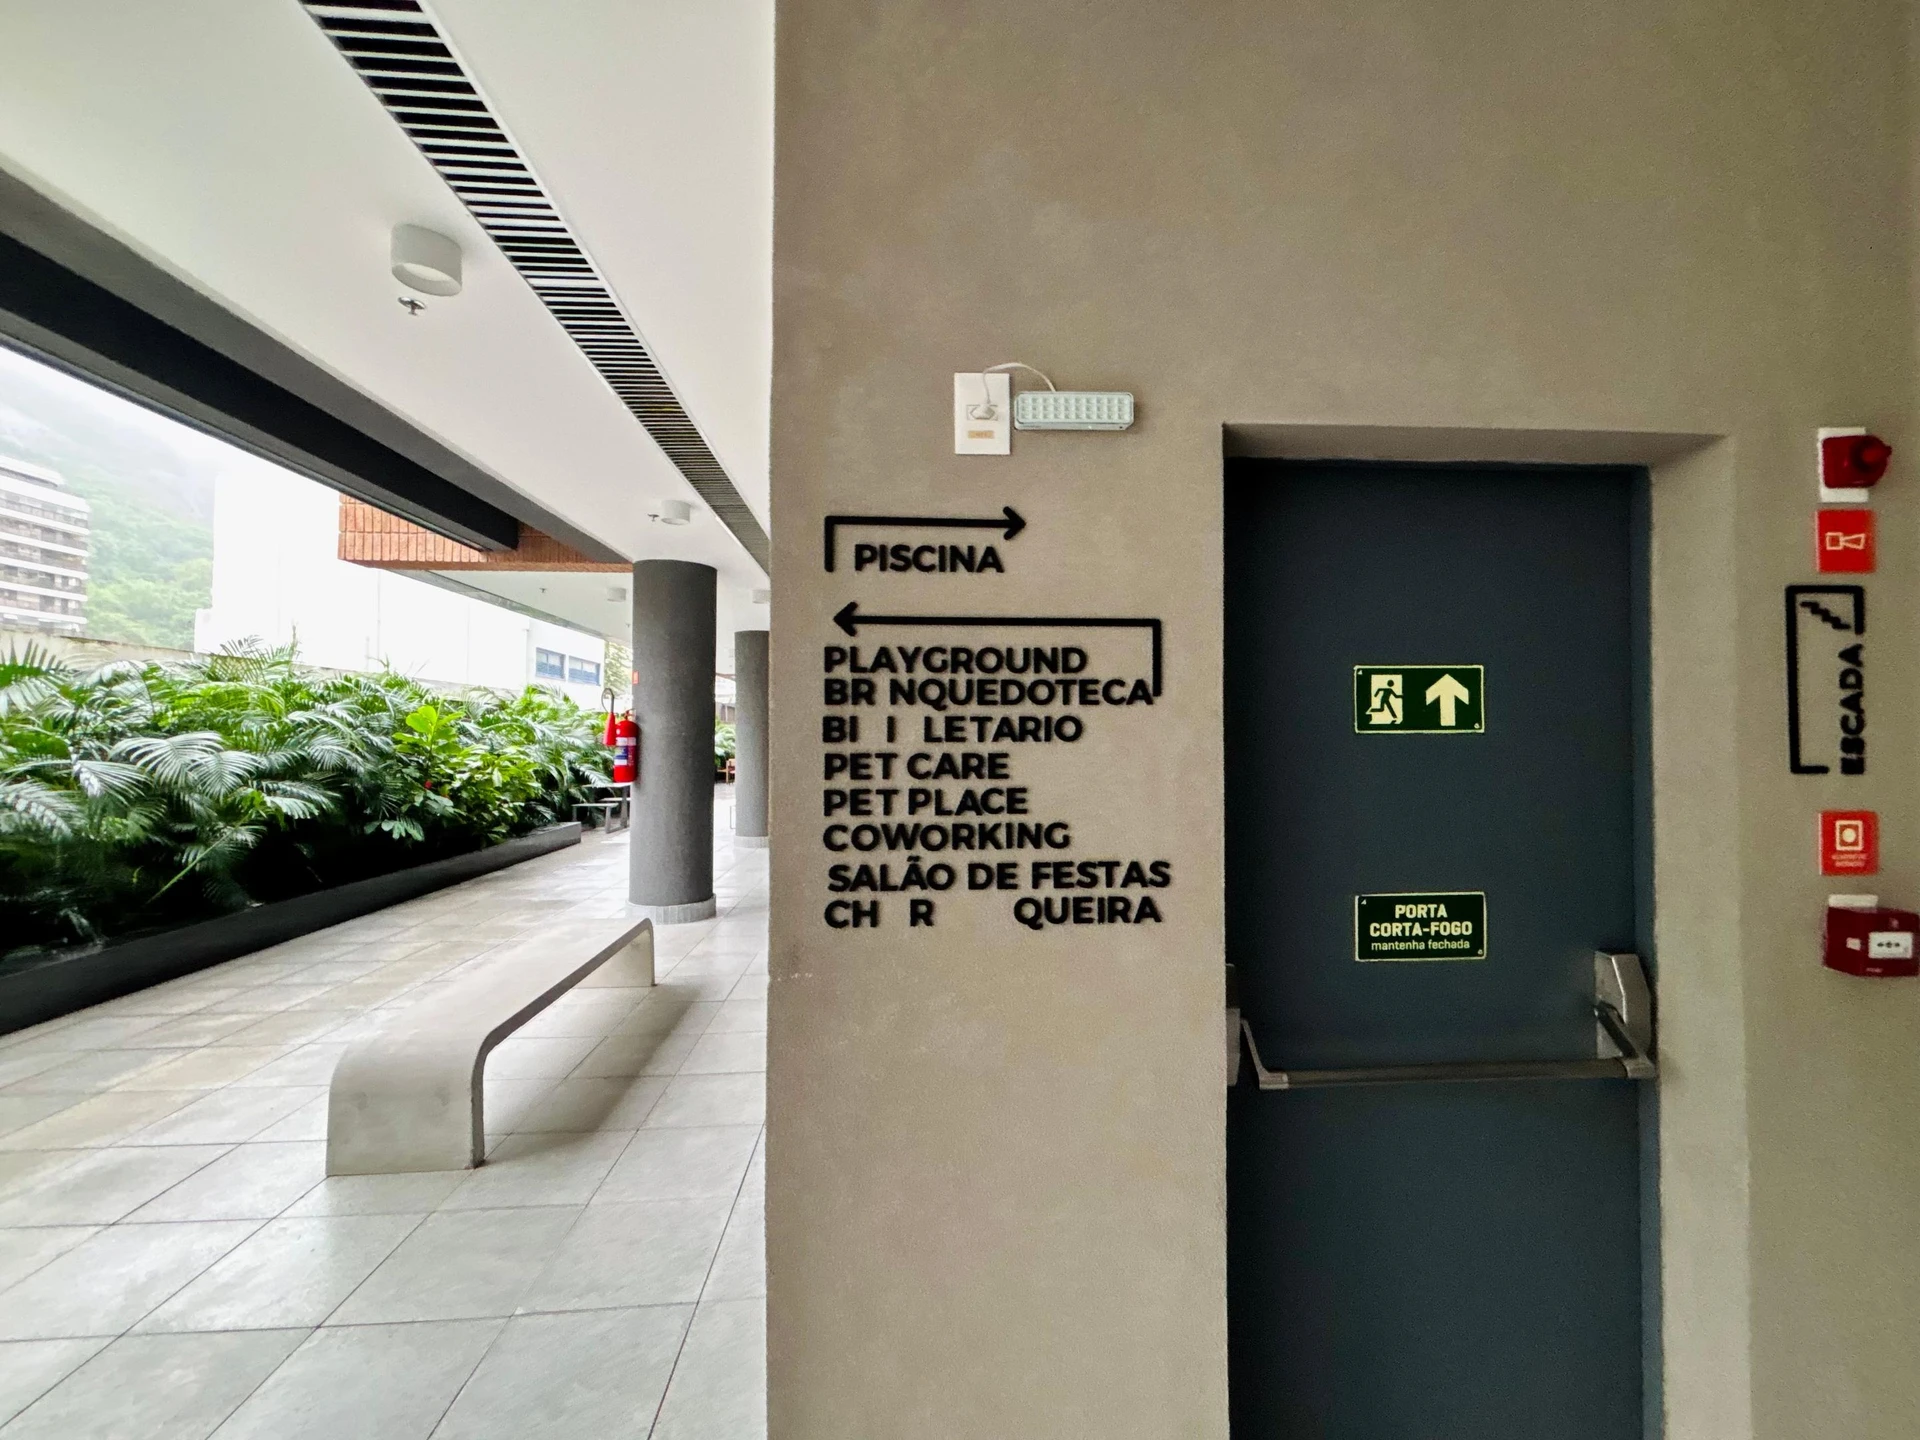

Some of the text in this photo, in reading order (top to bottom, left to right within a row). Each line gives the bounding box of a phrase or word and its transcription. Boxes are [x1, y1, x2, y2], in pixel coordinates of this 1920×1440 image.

[855, 544, 1004, 573] PISCINA
[824, 646, 1088, 674] PLAYGROUND
[824, 753, 1010, 780] PET CARE
[824, 787, 1028, 817] PET PLACE
[823, 822, 1070, 852] COWORKING
[828, 856, 1171, 892] SALÃO DE FESTAS
[1395, 904, 1448, 918] PORTA
[1370, 921, 1472, 937] CORTA-FOGO
[1371, 939, 1470, 951] mantenha fechada
